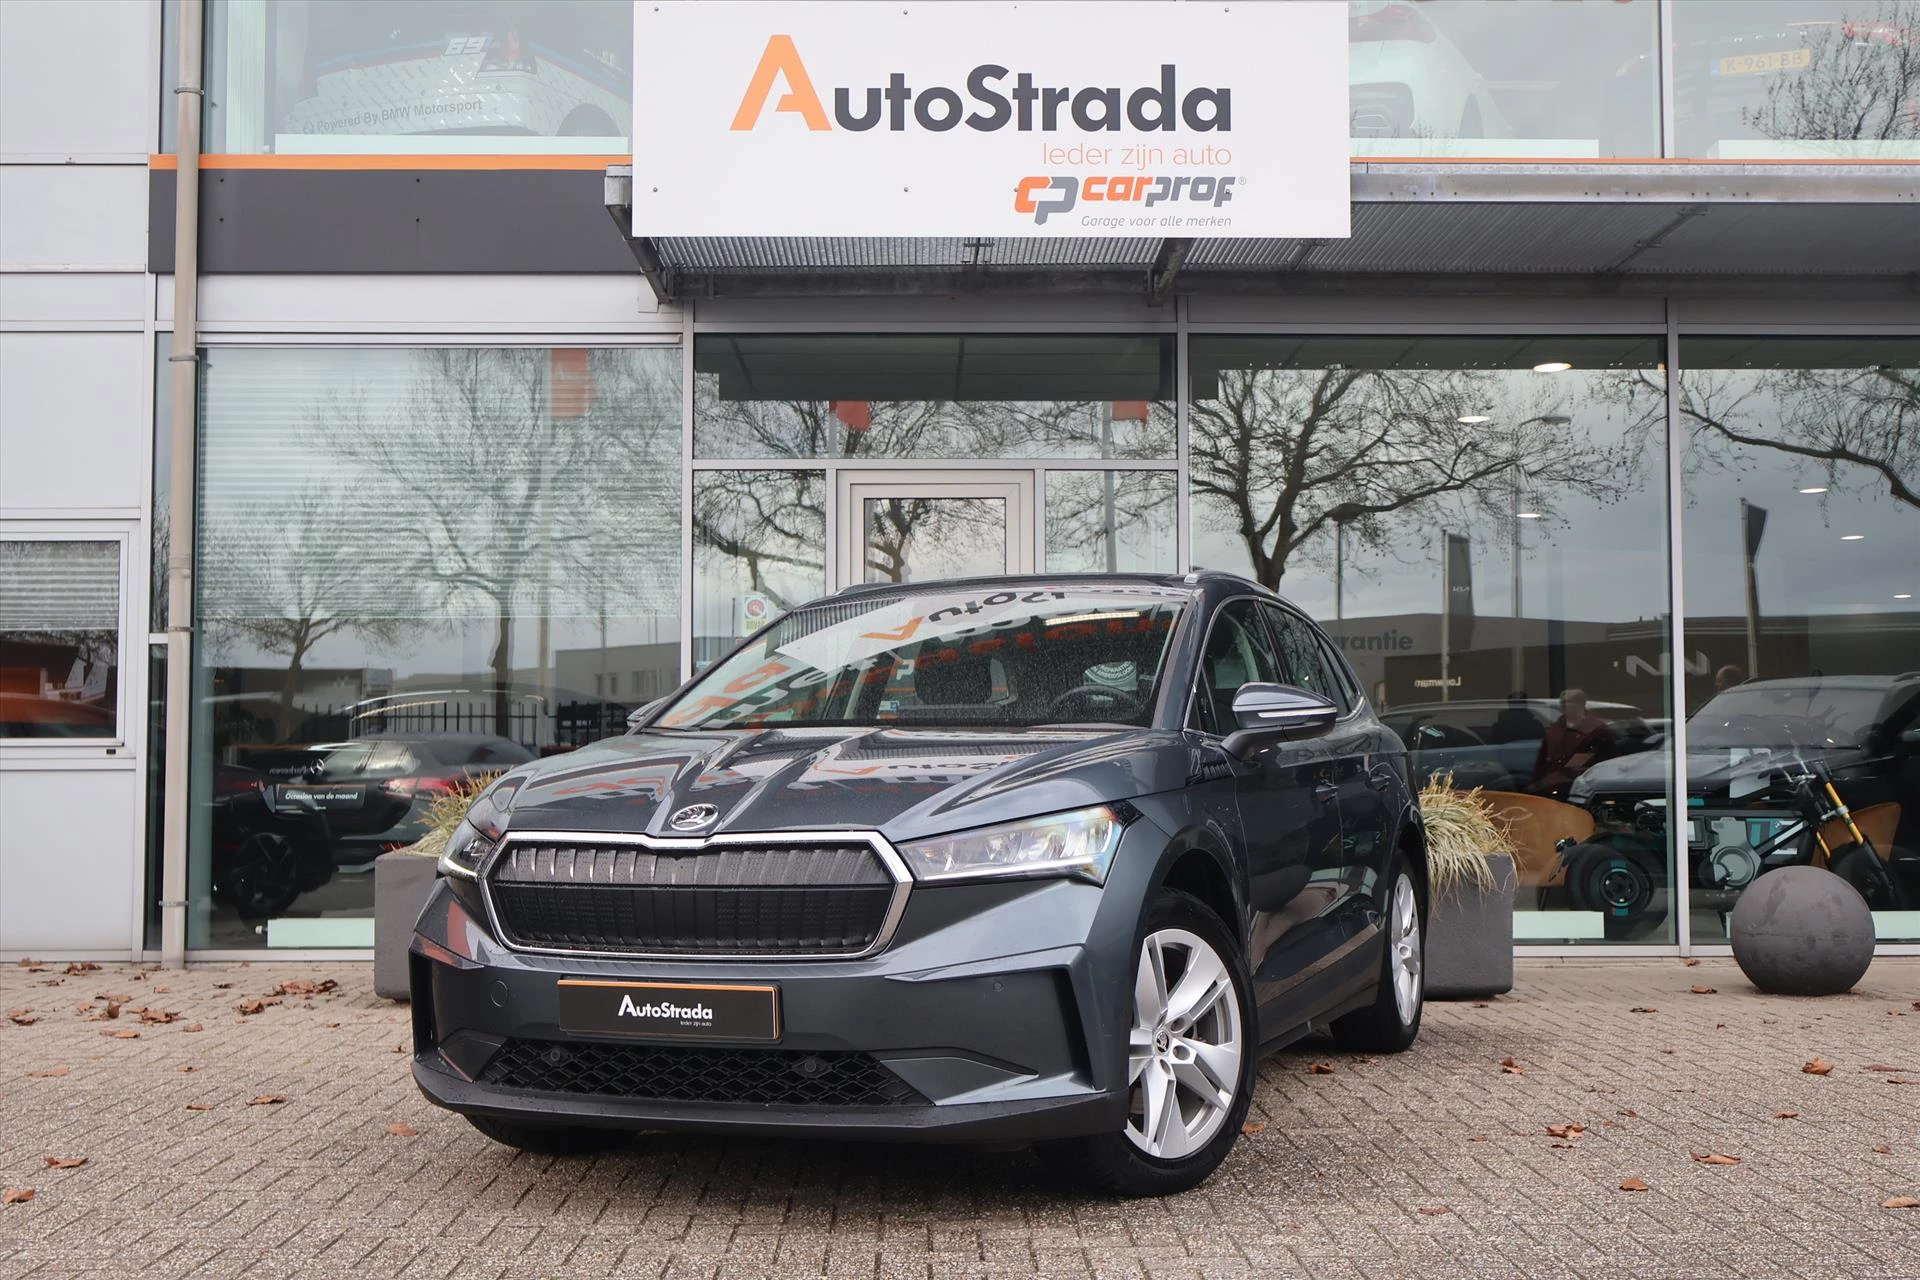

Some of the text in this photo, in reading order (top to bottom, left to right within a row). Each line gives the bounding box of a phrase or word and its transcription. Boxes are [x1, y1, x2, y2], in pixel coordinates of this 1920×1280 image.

[729, 34, 1231, 132] AutoStrada
[317, 99, 483, 132] Powered By BMW Motorsport
[1121, 143, 1163, 170] zijn
[1173, 145, 1232, 165] auto
[1081, 215, 1232, 228] Garage voor alle merken
[335, 792, 358, 800] maand
[618, 994, 713, 1019] AutoStrada
